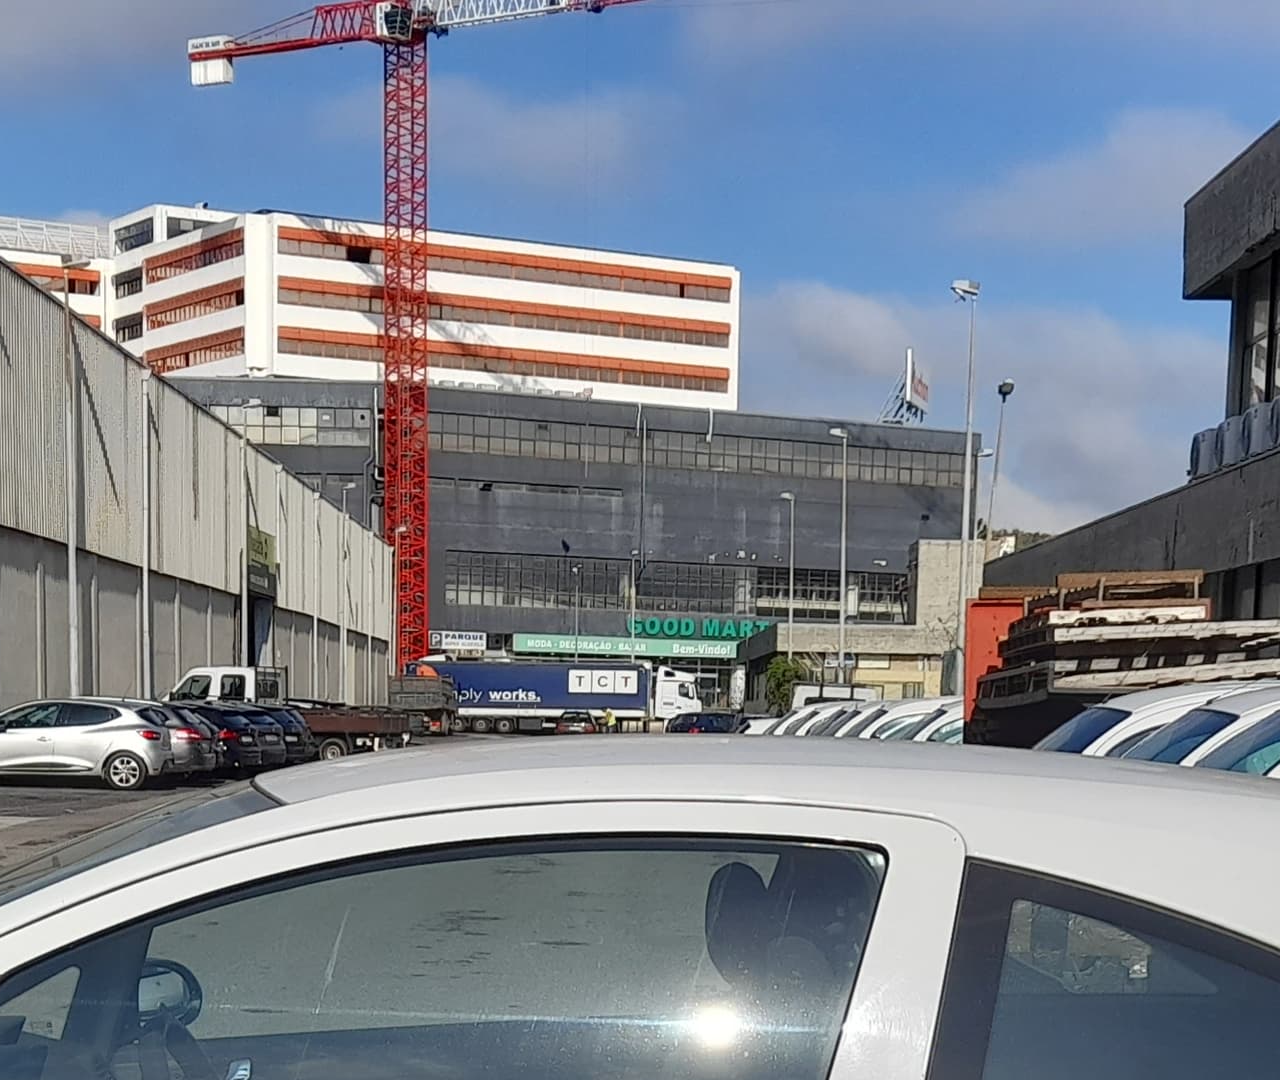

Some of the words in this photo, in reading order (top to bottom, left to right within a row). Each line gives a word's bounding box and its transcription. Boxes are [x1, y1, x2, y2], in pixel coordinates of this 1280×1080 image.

[626, 616, 696, 636] GOOD
[444, 633, 484, 641] PARQUE
[527, 639, 553, 649] MODA
[672, 643, 731, 655] Bem-Vindo!
[489, 688, 541, 702] works.
